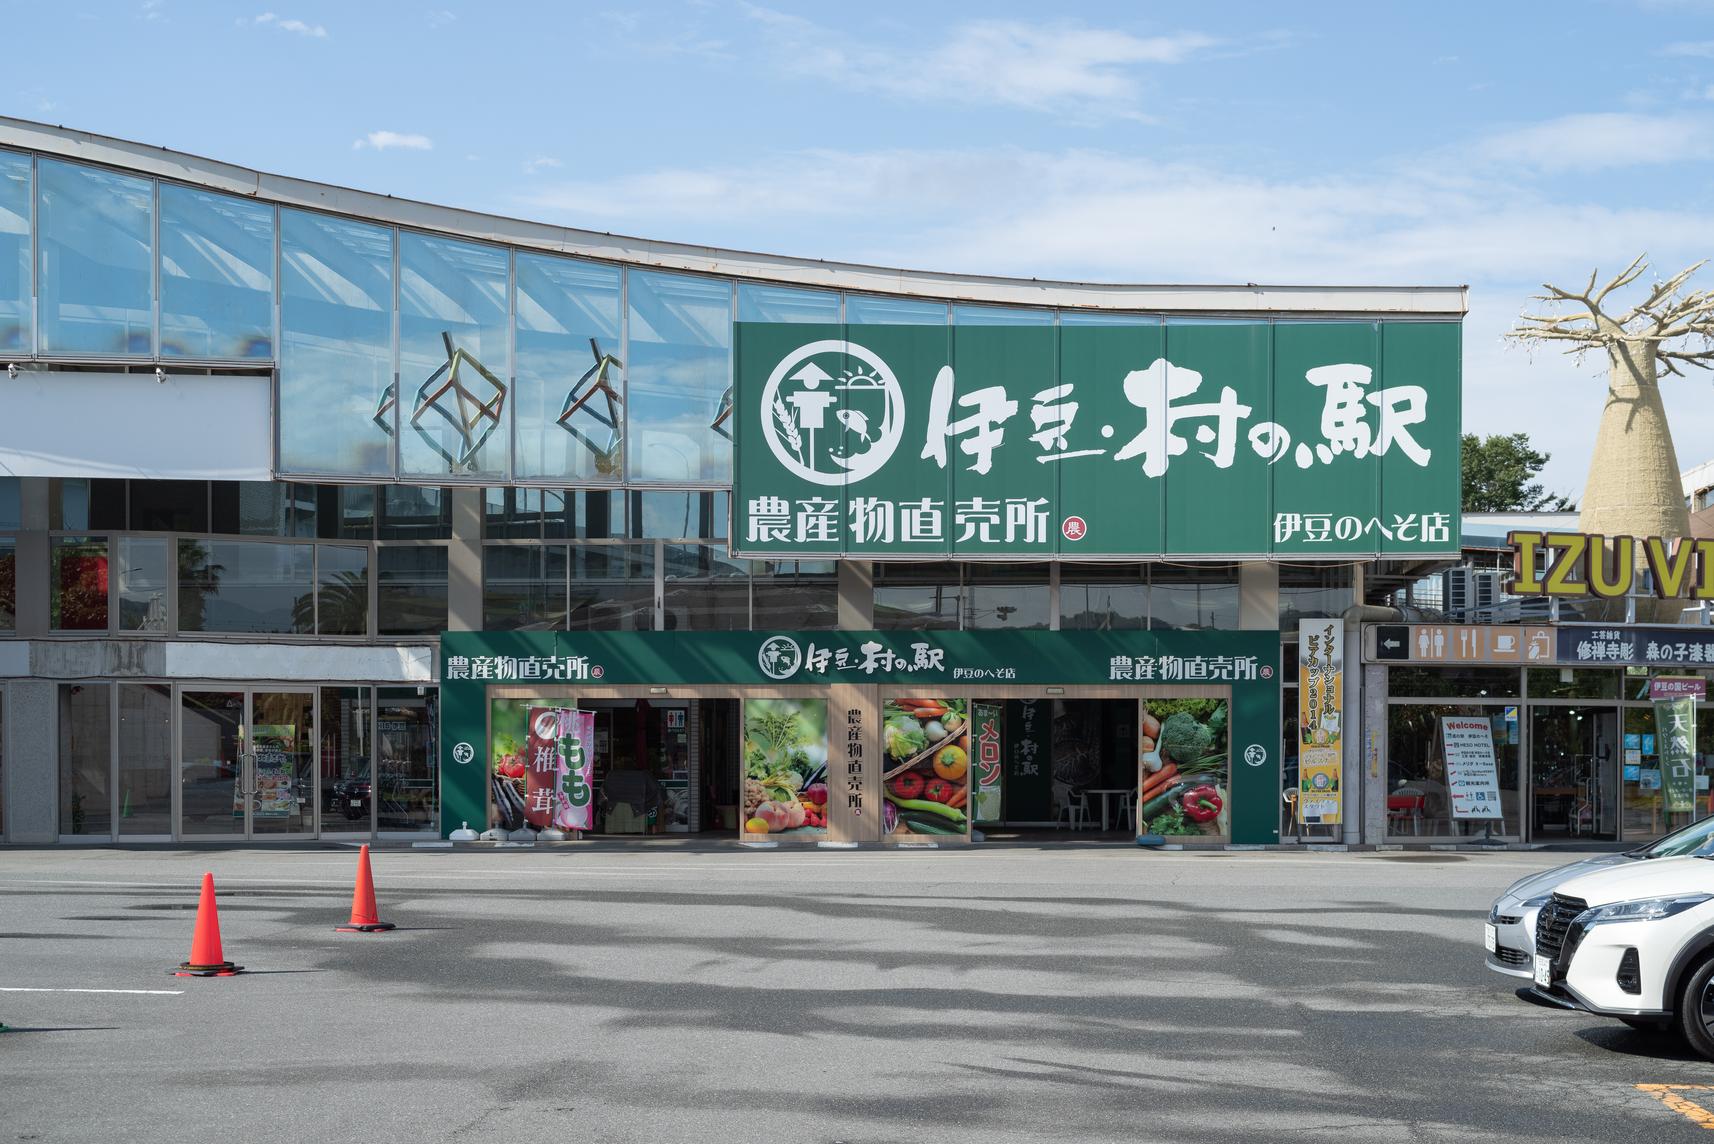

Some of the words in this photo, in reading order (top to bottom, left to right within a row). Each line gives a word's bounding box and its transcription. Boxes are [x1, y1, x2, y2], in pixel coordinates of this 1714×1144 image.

[921, 358, 1432, 479] 伊豆・村の駅
[746, 496, 1051, 544] 農産物直売所
[1273, 512, 1451, 543] 伊豆のへそ店
[1508, 531, 1634, 599] IZU
[1591, 630, 1621, 640] 工芸雑貨
[446, 656, 589, 680] 農産物直売所
[805, 640, 945, 674] 伊豆・村の駅
[952, 667, 1016, 679] 伊豆のへそ店
[1109, 655, 1259, 680] 農産物直売所
[1323, 624, 1337, 715] インターナショナル
[1654, 682, 1702, 691] 伊豆の国ビール
[1447, 722, 1488, 730] Welcome
[1668, 713, 1692, 778] 天然石
[558, 733, 591, 808] もも
[848, 709, 863, 808] 農産物直売所
[979, 719, 1001, 785] メロン
